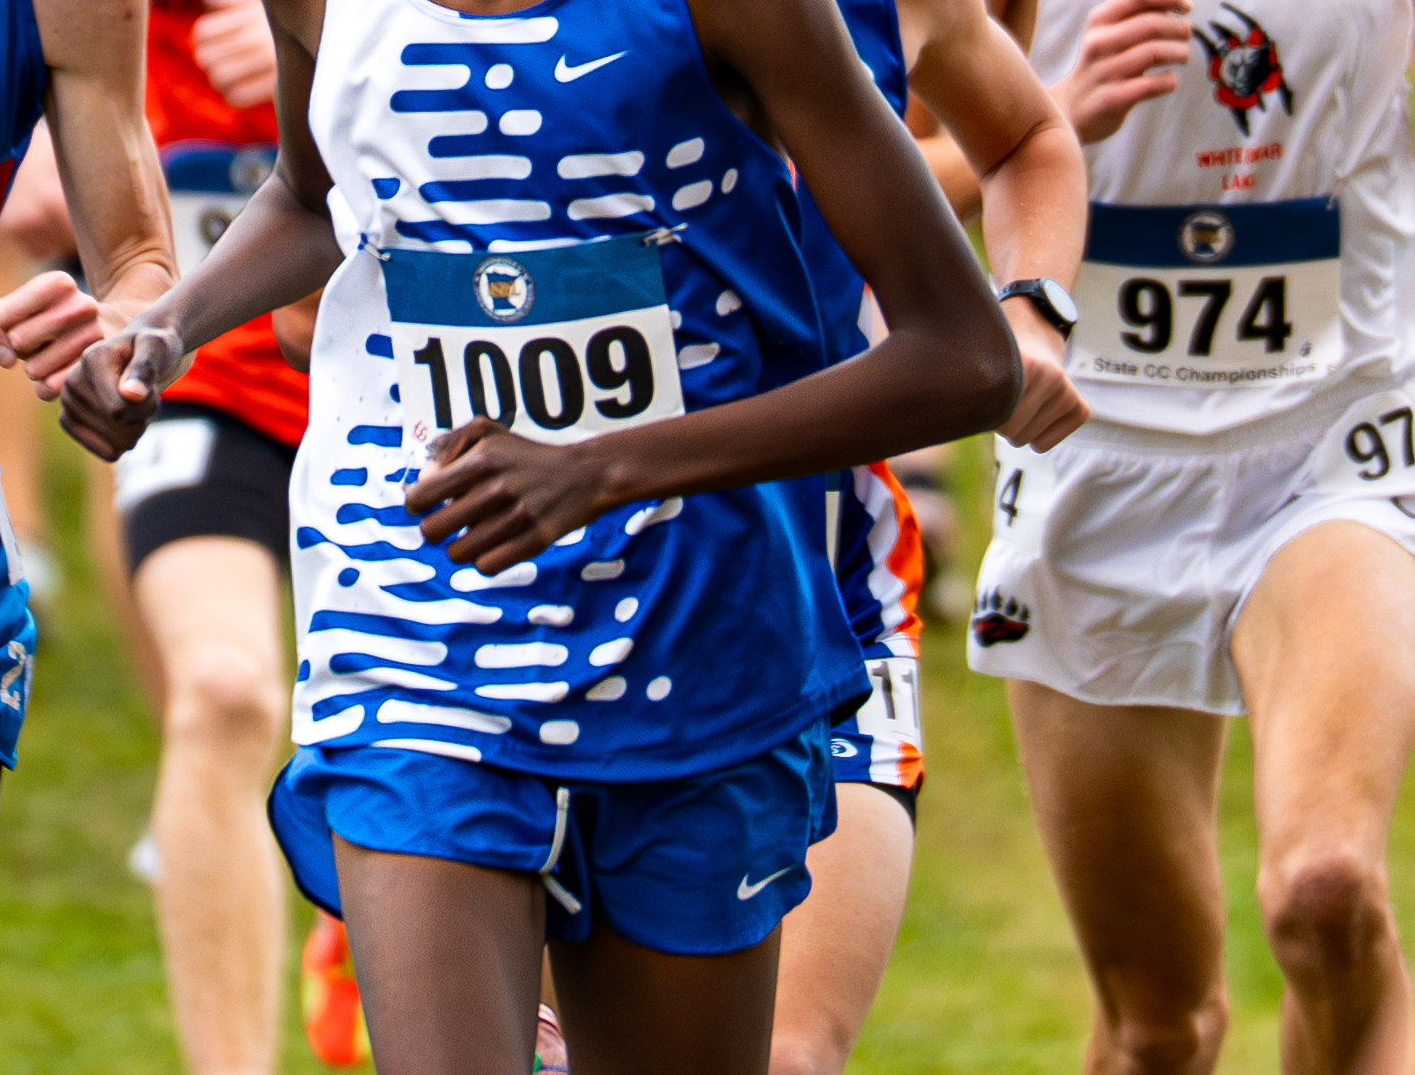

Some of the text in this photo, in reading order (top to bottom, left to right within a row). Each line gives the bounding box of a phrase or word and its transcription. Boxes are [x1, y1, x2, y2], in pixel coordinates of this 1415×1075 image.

[1117, 275, 1293, 356] 974
[413, 325, 655, 430] 1009
[1093, 357, 1138, 375] State
[1143, 364, 1172, 379] CC
